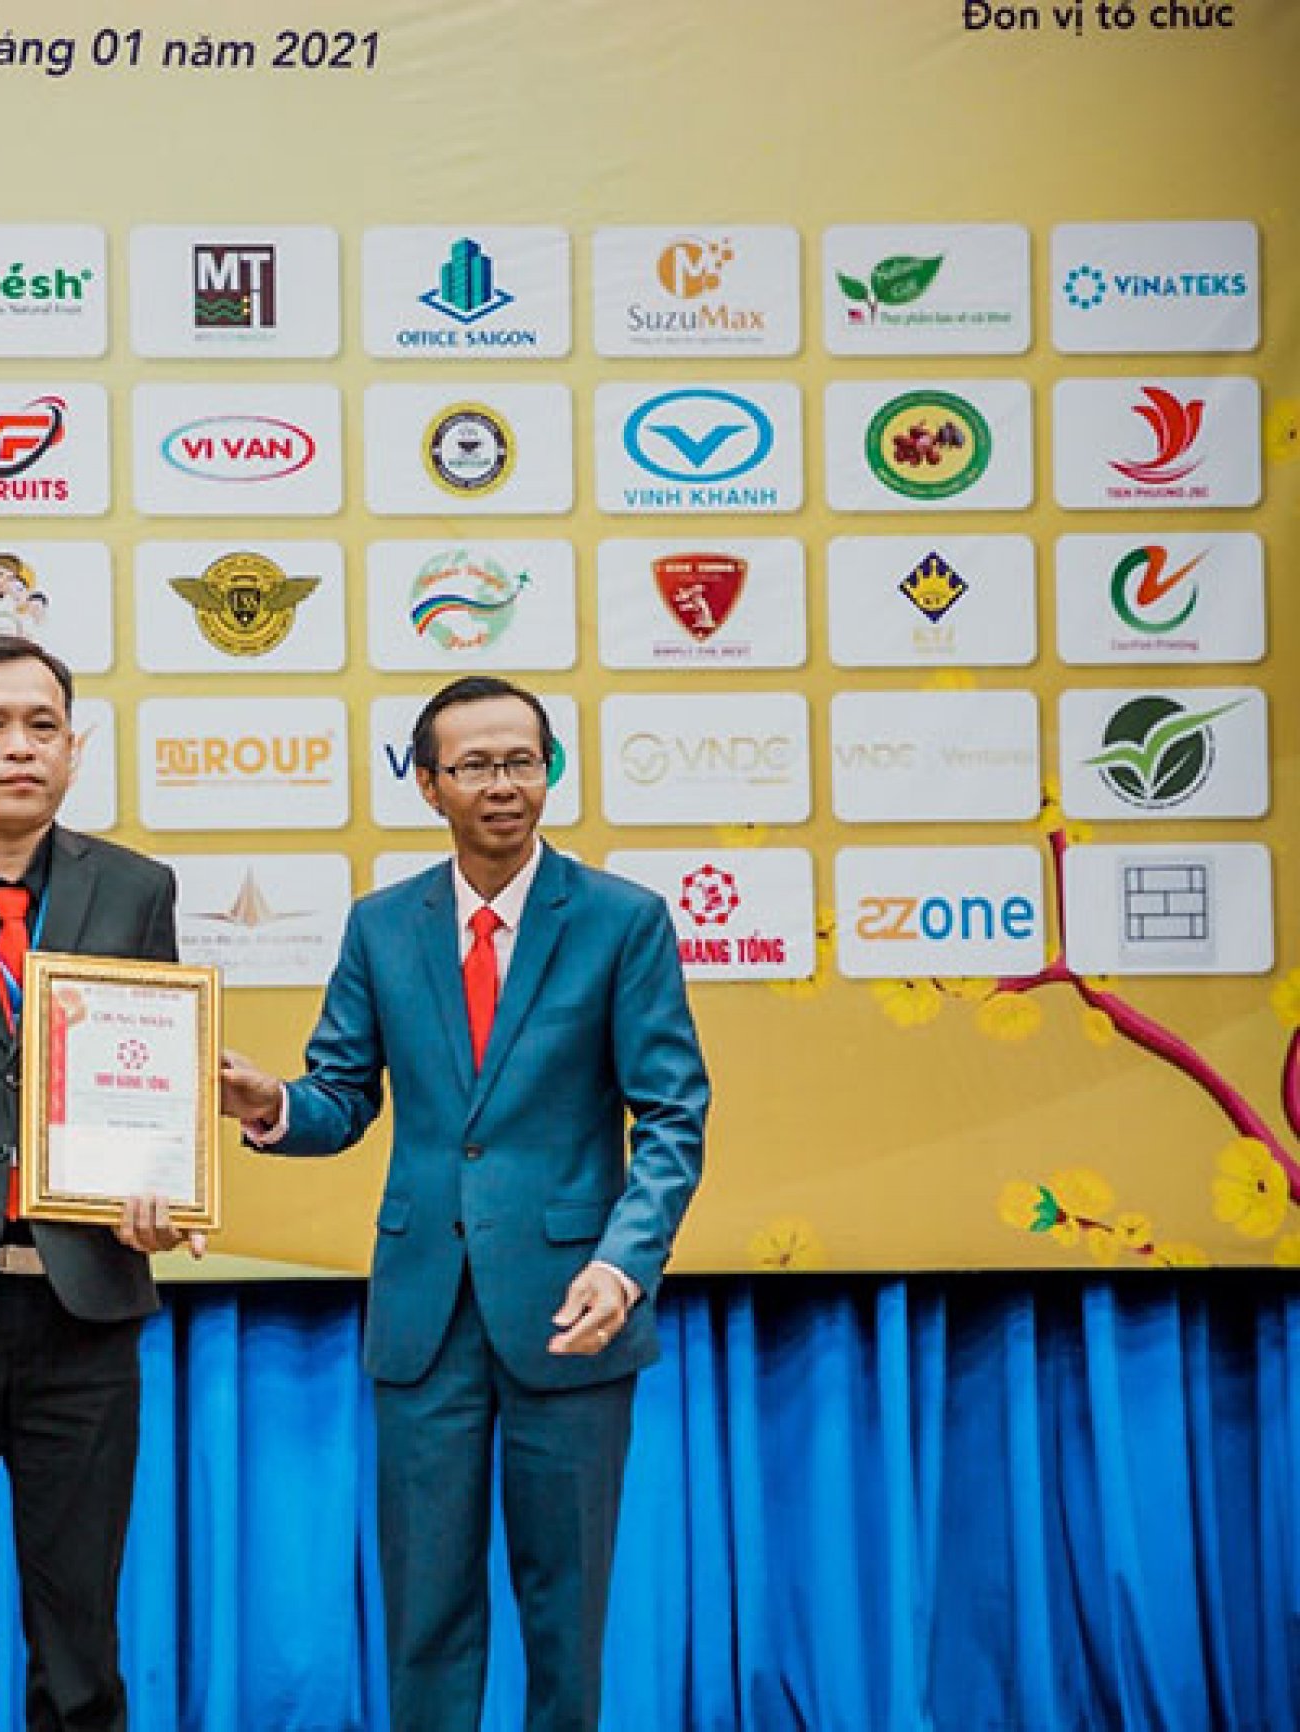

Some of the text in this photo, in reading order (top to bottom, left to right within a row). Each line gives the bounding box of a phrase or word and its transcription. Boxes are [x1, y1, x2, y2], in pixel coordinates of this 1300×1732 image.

[1052, 0, 1083, 37] vị
[91, 28, 142, 66] 01
[162, 35, 256, 68] năm
[271, 30, 380, 68] 2021
[627, 302, 766, 333] SuzuMax
[465, 330, 537, 347] SAIGON
[181, 437, 293, 461] VI VAN
[624, 489, 682, 507] VINH
